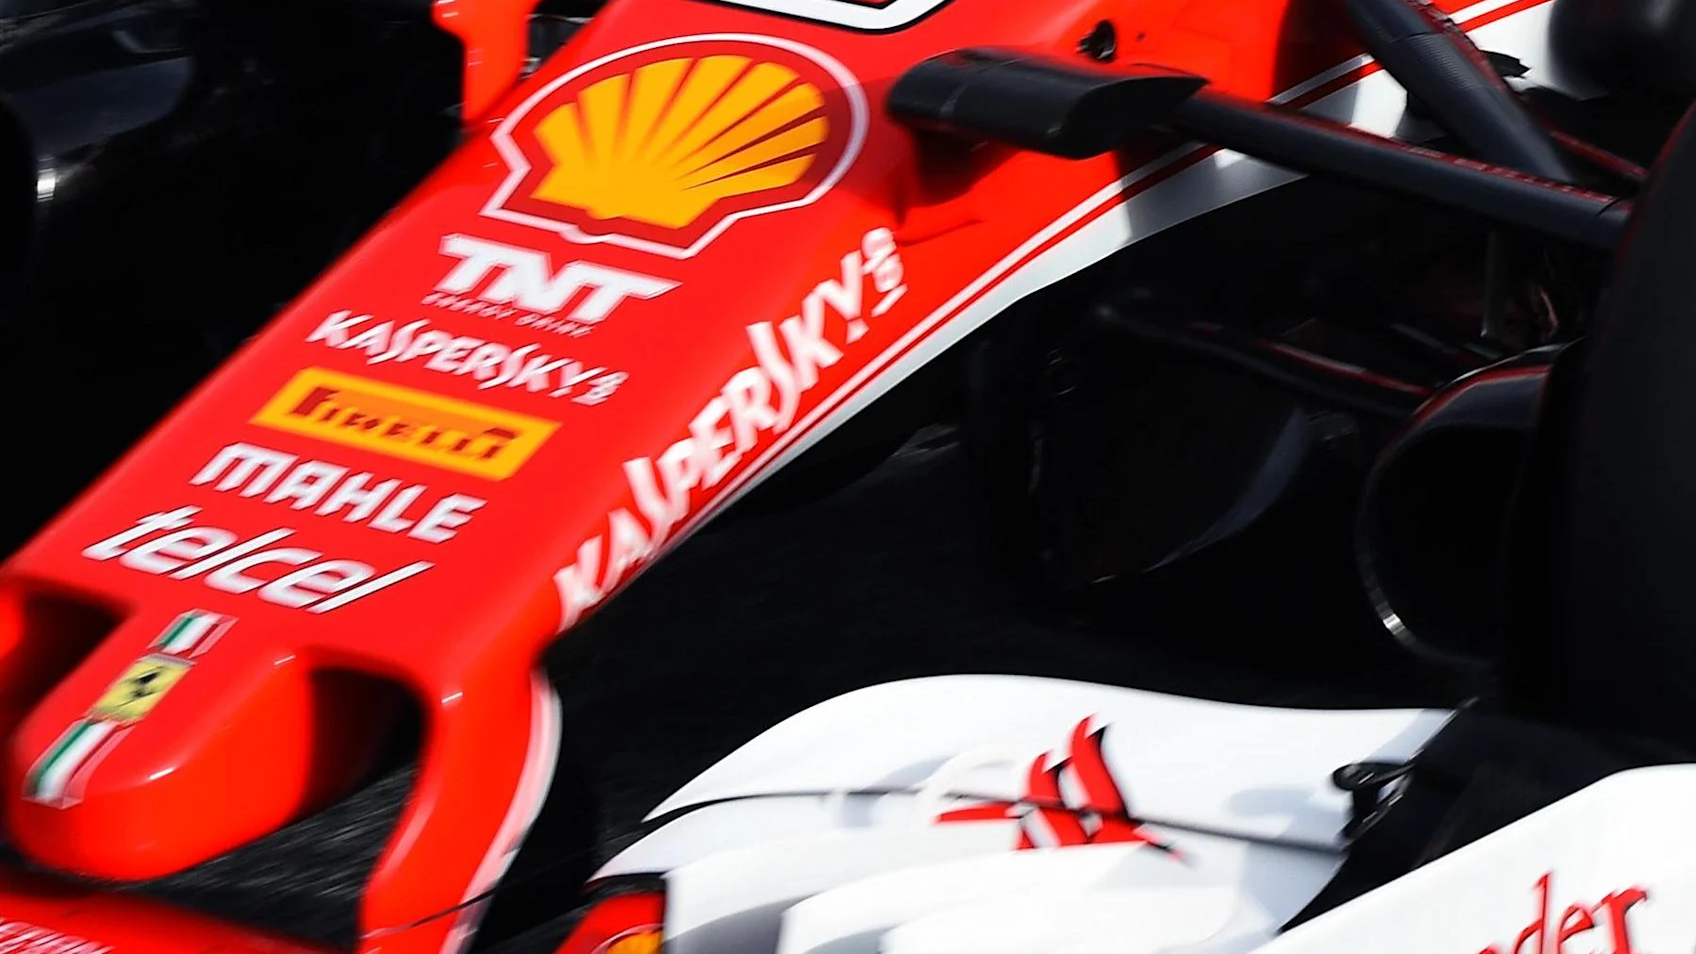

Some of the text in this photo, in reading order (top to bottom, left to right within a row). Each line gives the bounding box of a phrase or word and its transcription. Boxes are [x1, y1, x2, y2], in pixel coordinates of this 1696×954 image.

[432, 232, 684, 324] TNT
[305, 310, 608, 398] KASPERSKY
[189, 441, 489, 544] MAHLE
[553, 248, 870, 636] KASPERSKY
[82, 504, 436, 615] telcel
